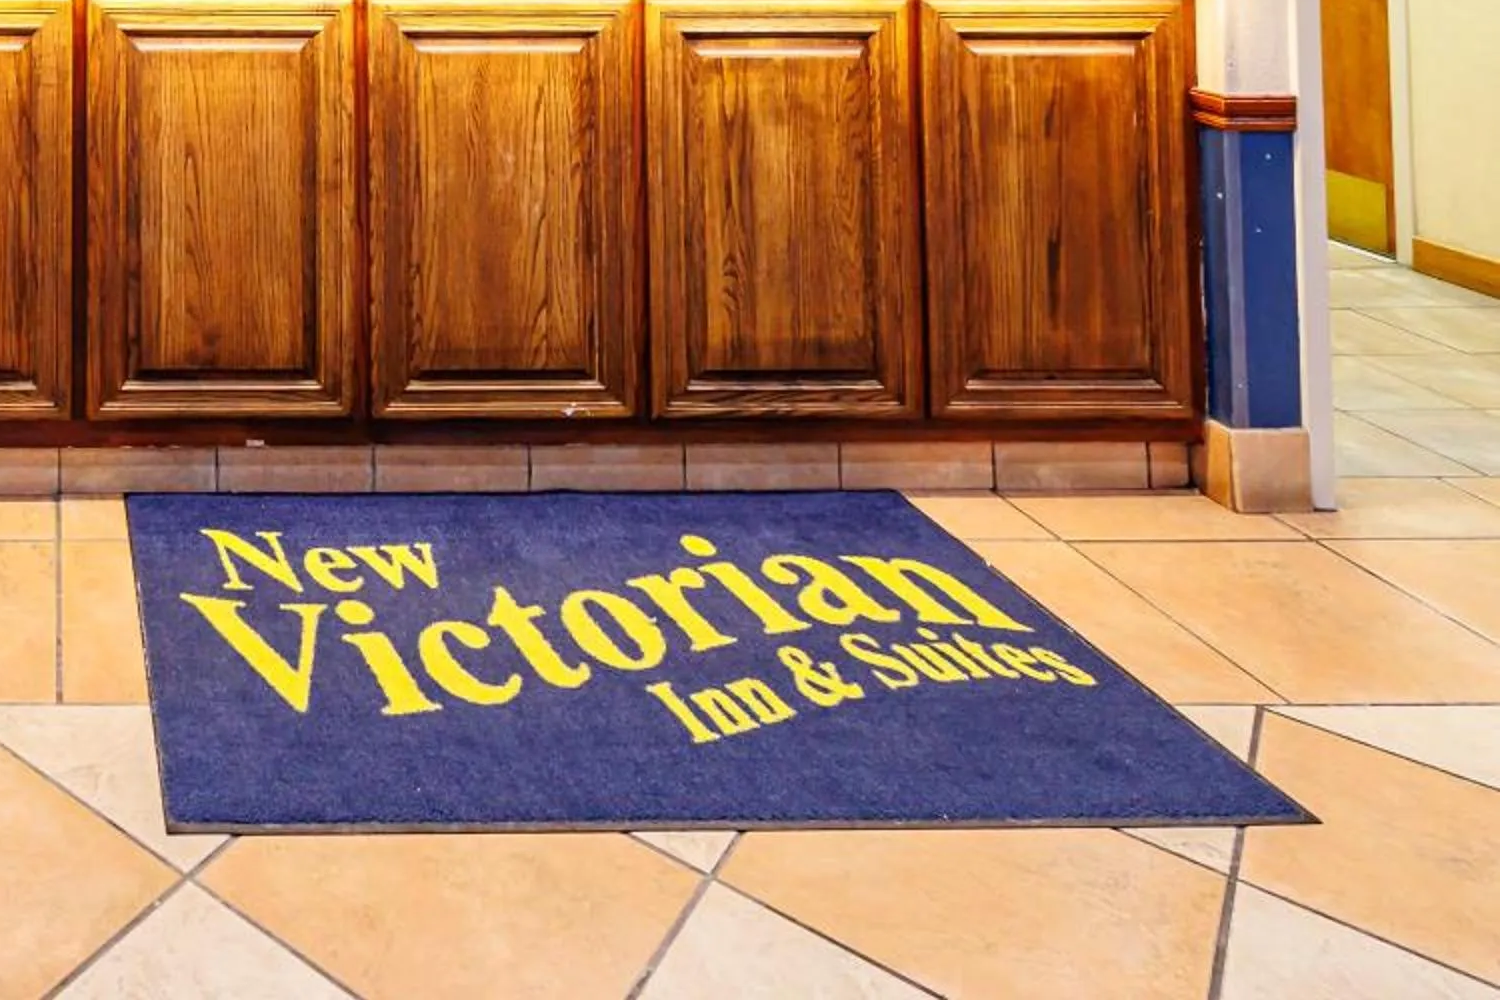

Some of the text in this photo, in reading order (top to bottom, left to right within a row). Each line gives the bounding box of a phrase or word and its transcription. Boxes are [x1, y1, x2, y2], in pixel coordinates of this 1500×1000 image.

[200, 528, 440, 594] New
[180, 534, 1036, 716] Victorian
[646, 630, 1098, 744] Inn & Suites
